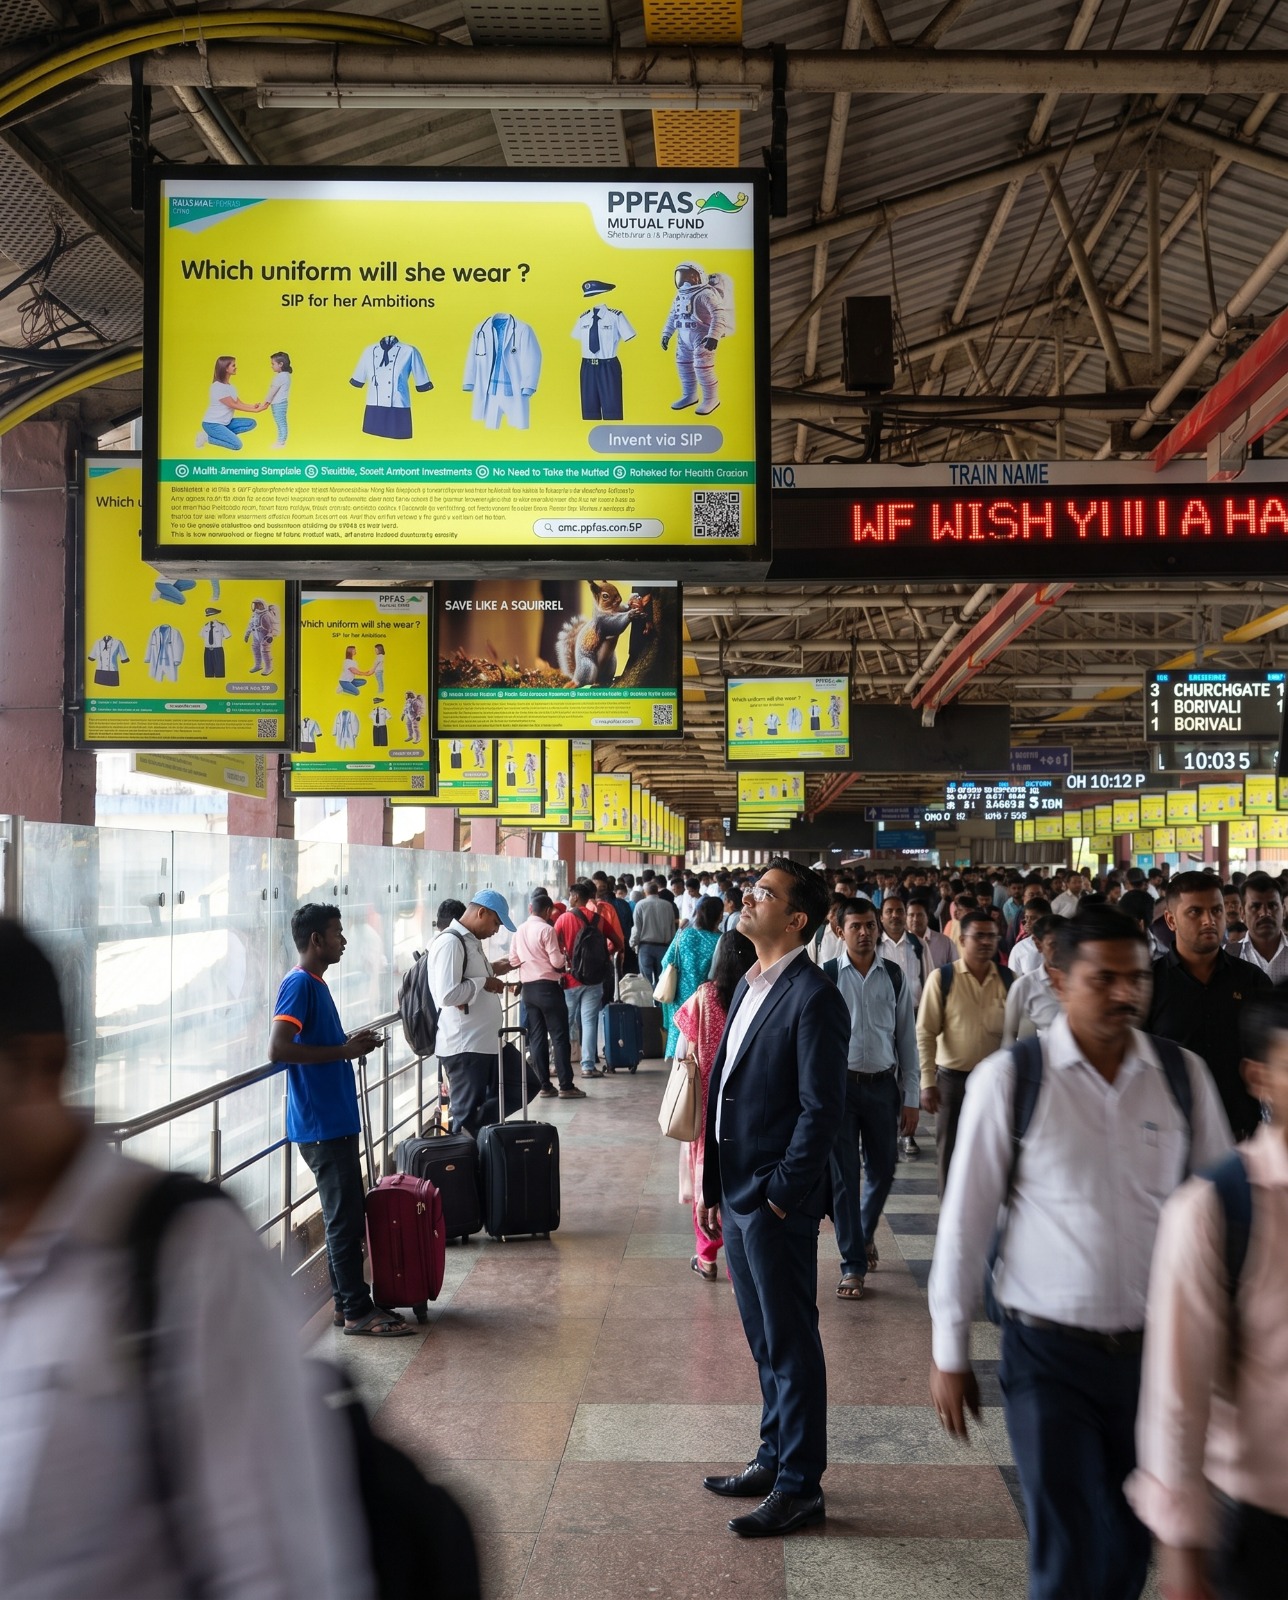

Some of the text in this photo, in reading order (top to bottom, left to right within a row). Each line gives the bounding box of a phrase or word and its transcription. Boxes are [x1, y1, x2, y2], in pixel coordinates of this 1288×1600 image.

[608, 191, 693, 213] PPFAS
[608, 218, 704, 229] MUTUAL FUND
[181, 260, 531, 283] Which uniform will she wear ?
[281, 294, 435, 308] SIP for her Ambitions
[609, 433, 703, 446] Invent via SIP
[422, 467, 472, 476] Investments
[493, 468, 505, 476] No
[508, 468, 530, 476] Need
[532, 468, 541, 476] to
[543, 468, 564, 477] Take
[566, 468, 579, 477] the
[669, 468, 682, 477] for
[684, 468, 714, 477] Health
[949, 464, 997, 485] TRAIN
[1002, 463, 1049, 485] NAME
[96, 496, 134, 507] Which
[932, 501, 1052, 540] WISH
[1182, 500, 1211, 536] A
[445, 600, 564, 611] SAVE LIKE A SQUIRREL
[327, 620, 359, 628] uniform
[361, 620, 374, 628] will
[377, 620, 391, 628] she
[415, 620, 421, 628] ?
[1150, 683, 1160, 697] 3
[1174, 683, 1270, 697] CHURCHGATE
[1151, 699, 1158, 714] 1
[1174, 699, 1241, 714] BORIVALI
[1151, 717, 1241, 731] 1 BORIVALI
[1091, 774, 1132, 788] 10:12
[1136, 774, 1145, 788] P
